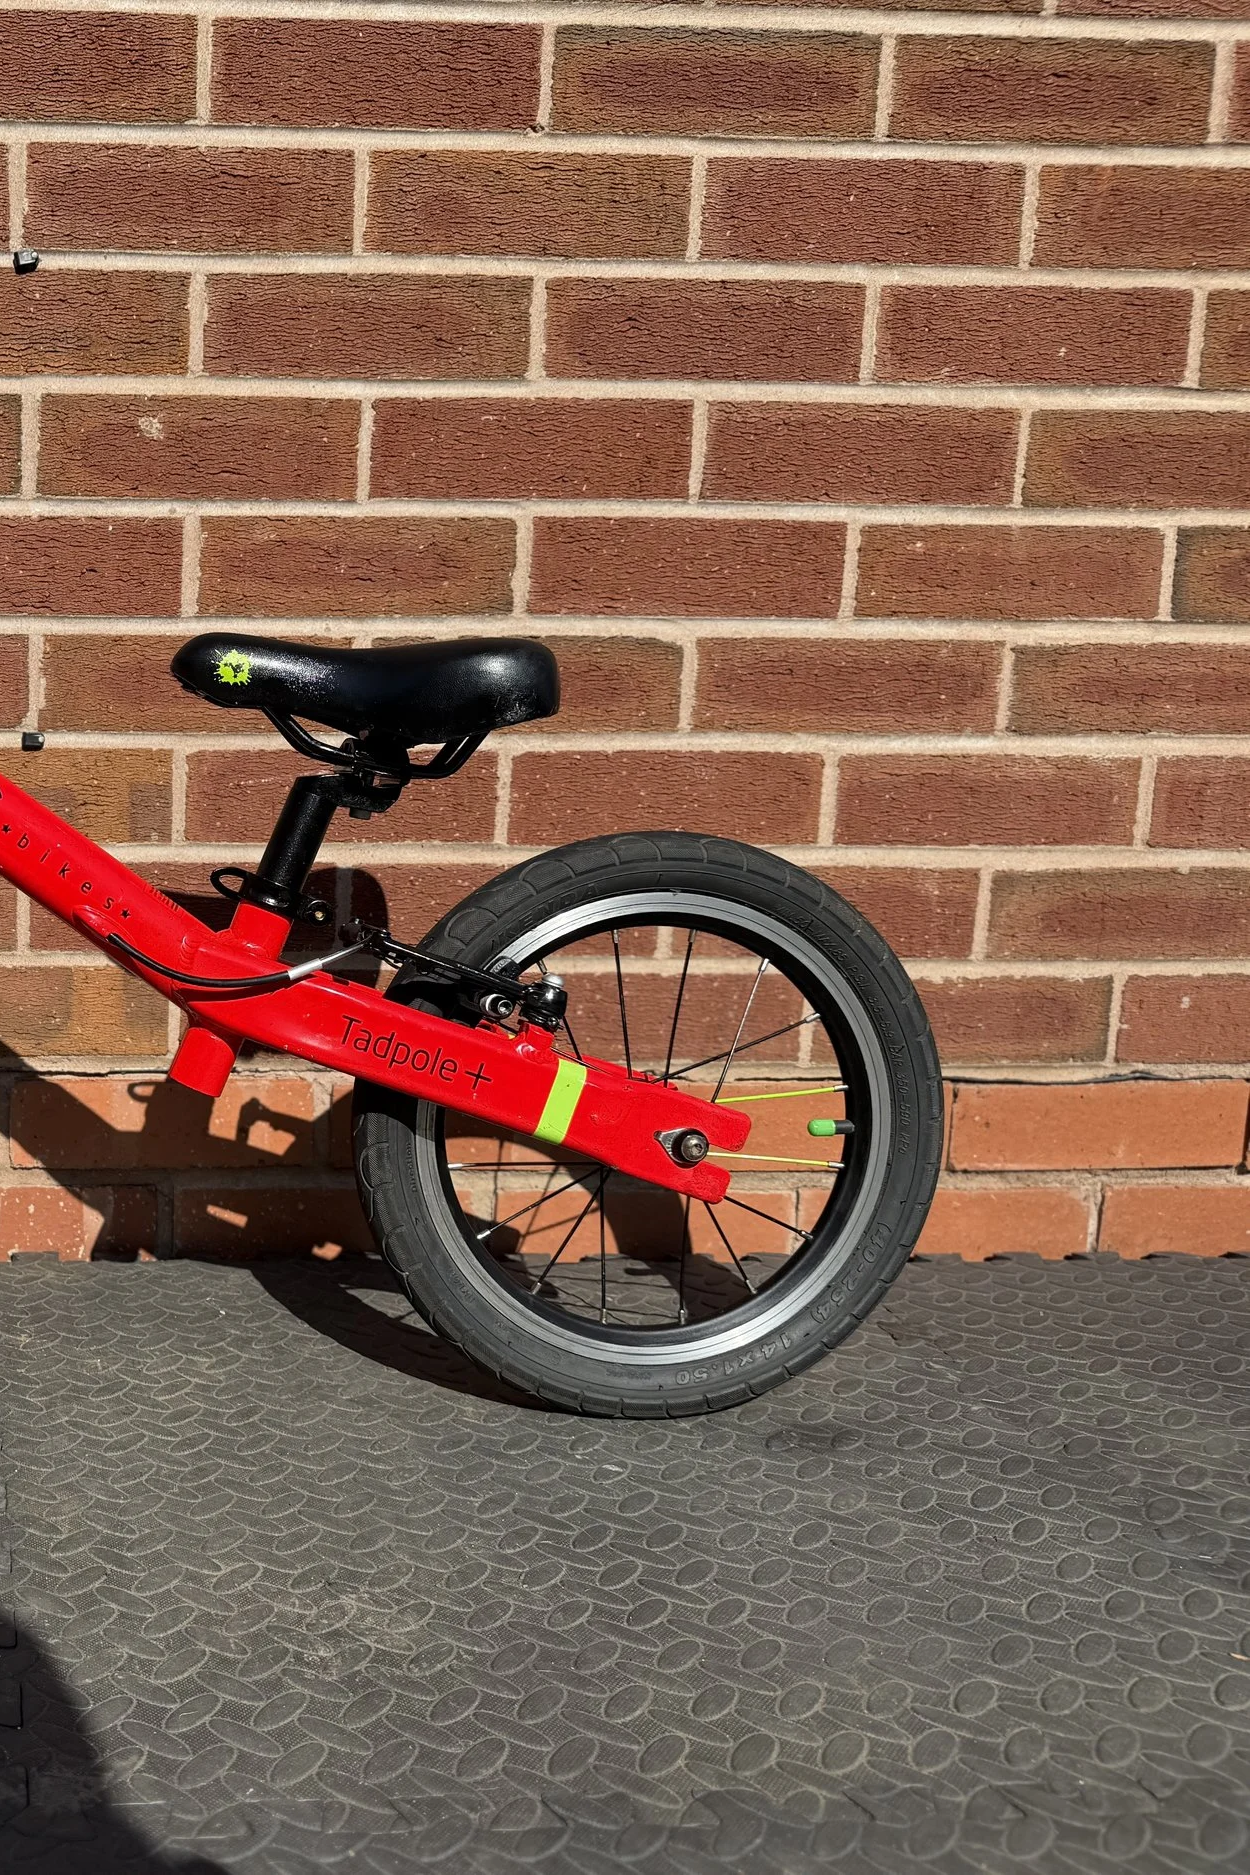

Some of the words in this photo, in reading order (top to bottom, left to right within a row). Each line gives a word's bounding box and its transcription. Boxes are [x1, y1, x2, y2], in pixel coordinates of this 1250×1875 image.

[16, 834, 117, 910] bikes
[886, 1042, 904, 1068] BAR
[810, 1221, 892, 1325] (40-254)
